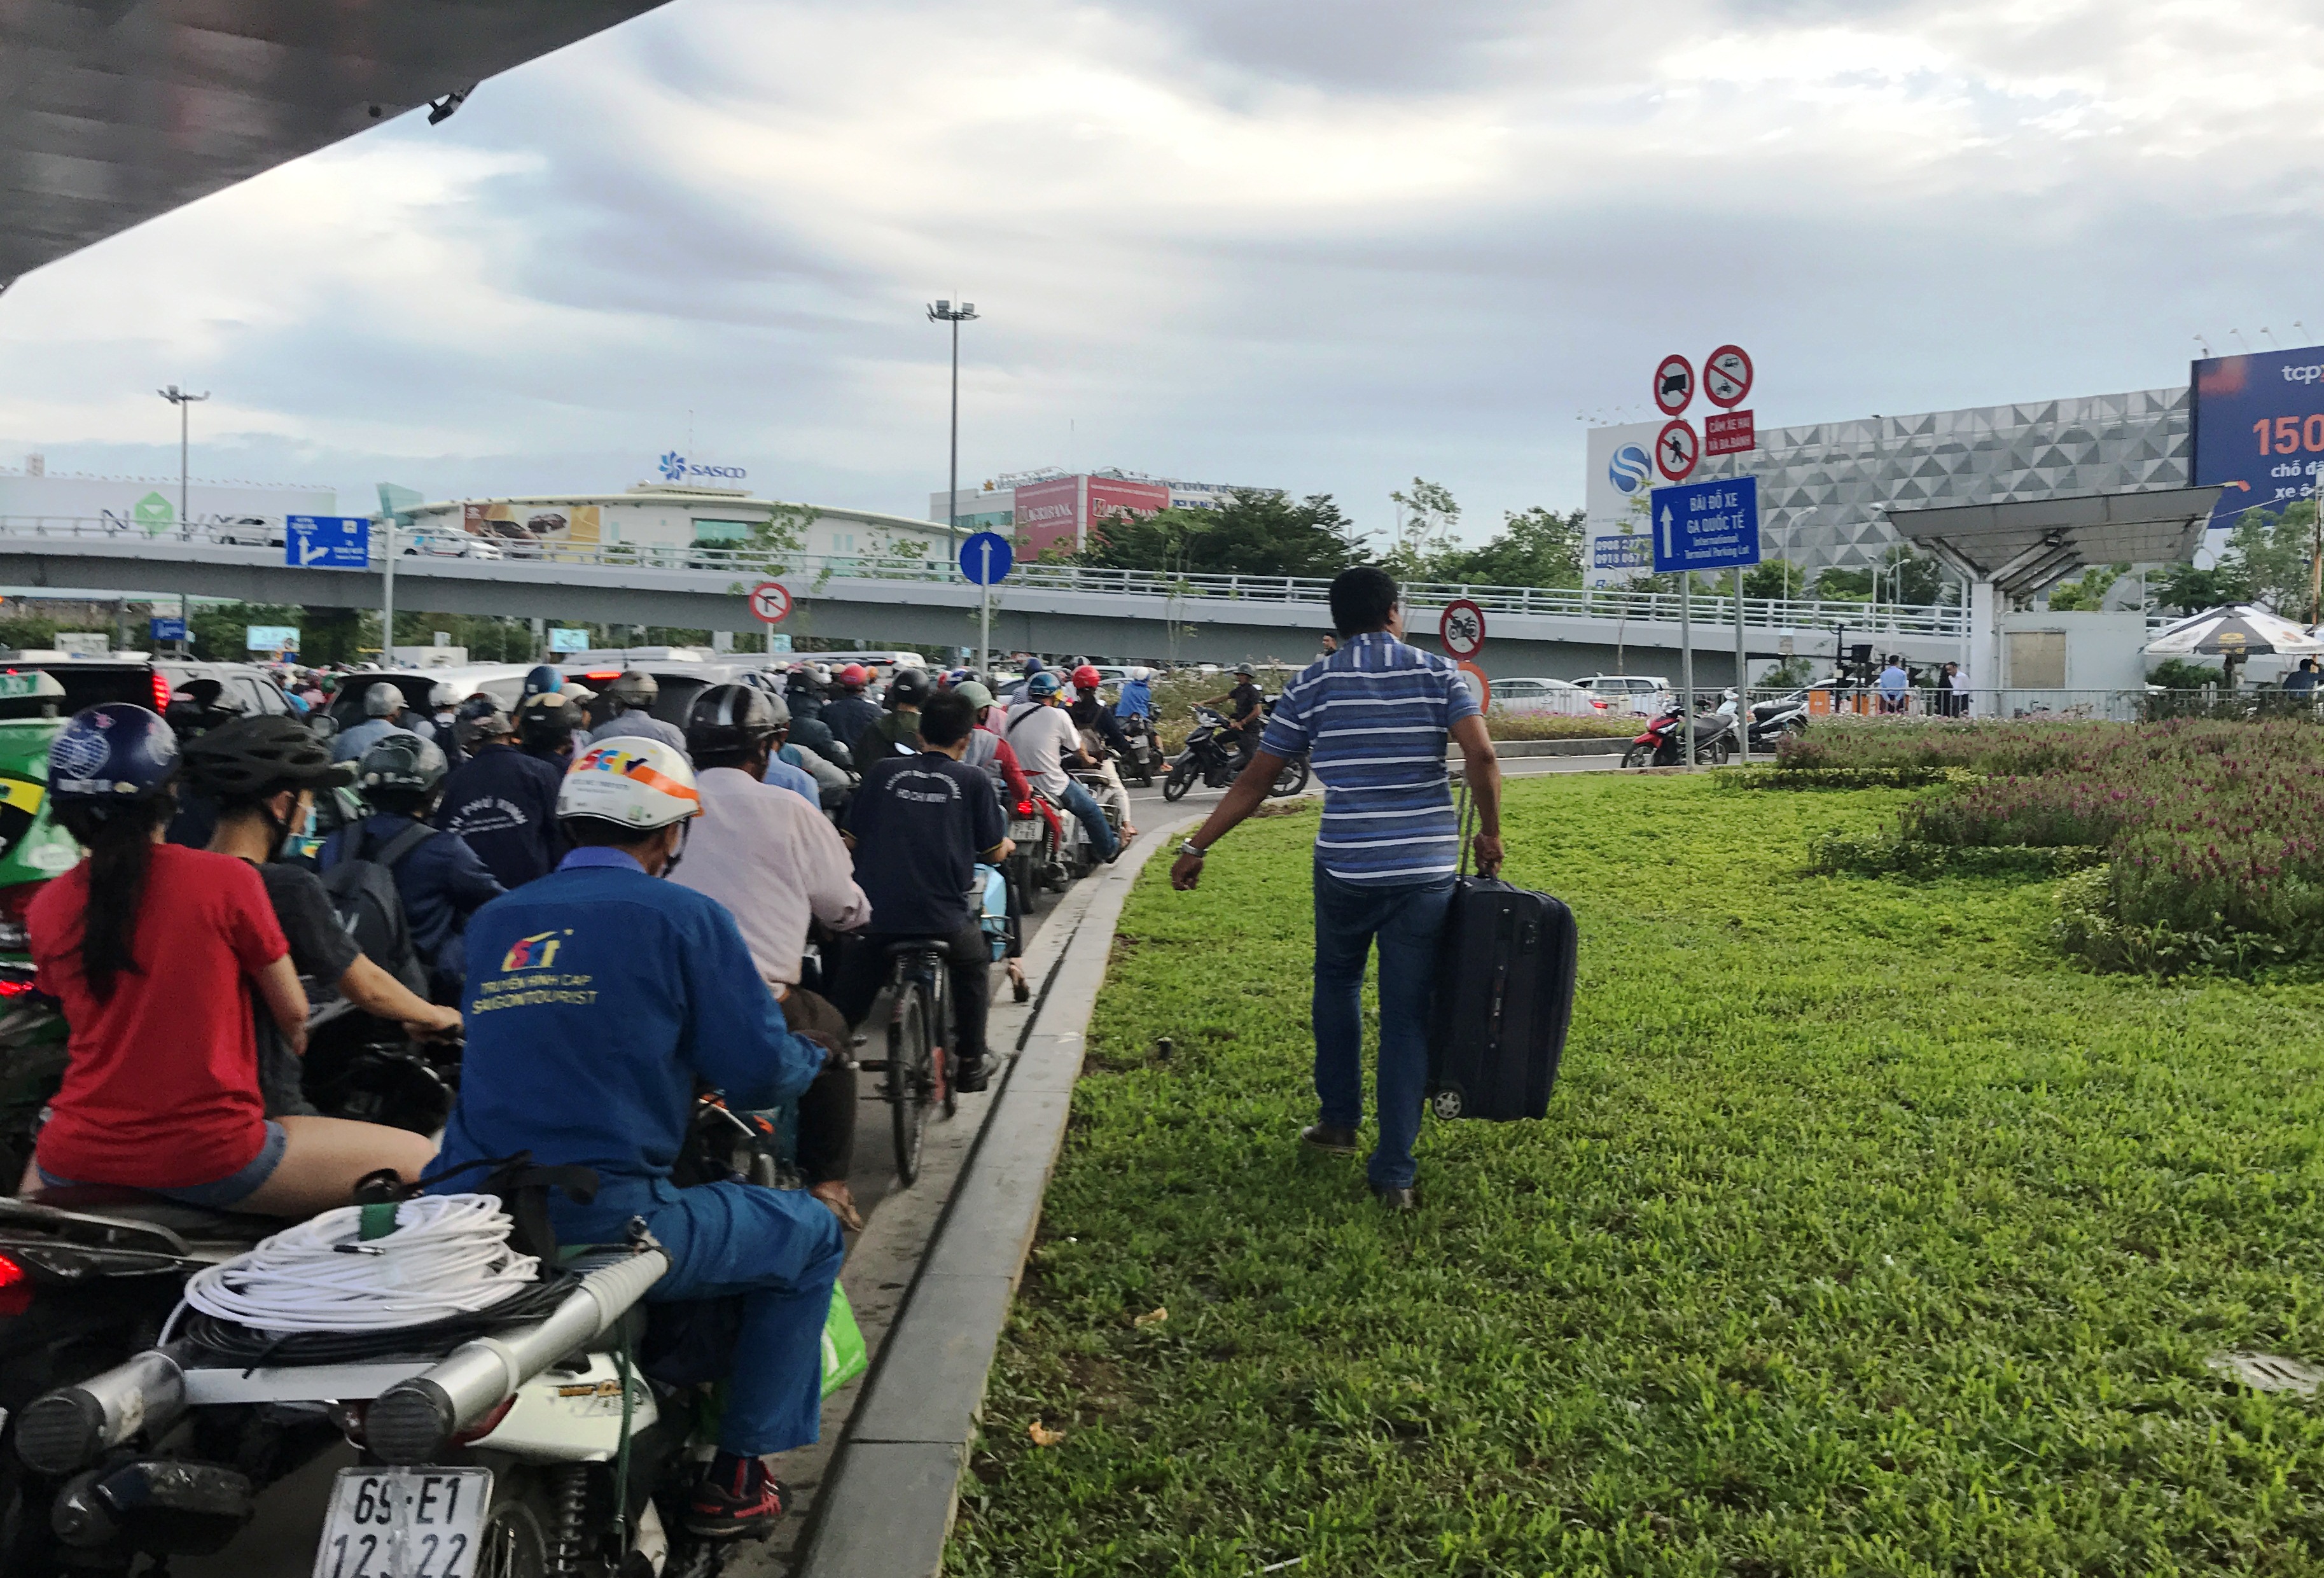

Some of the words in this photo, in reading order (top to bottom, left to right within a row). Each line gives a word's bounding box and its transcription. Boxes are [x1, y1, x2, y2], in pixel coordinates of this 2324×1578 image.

[690, 464, 746, 478] SASCO
[2271, 459, 2301, 477] chỗ
[1725, 492, 1739, 508] XE
[2274, 487, 2296, 499] xe
[1687, 519, 1701, 534] GA
[1702, 510, 1730, 532] QUỐC
[1731, 508, 1745, 529] TẾ
[1693, 533, 1739, 547] International
[1685, 547, 1711, 559] Terminal
[1713, 546, 1737, 557] Parking
